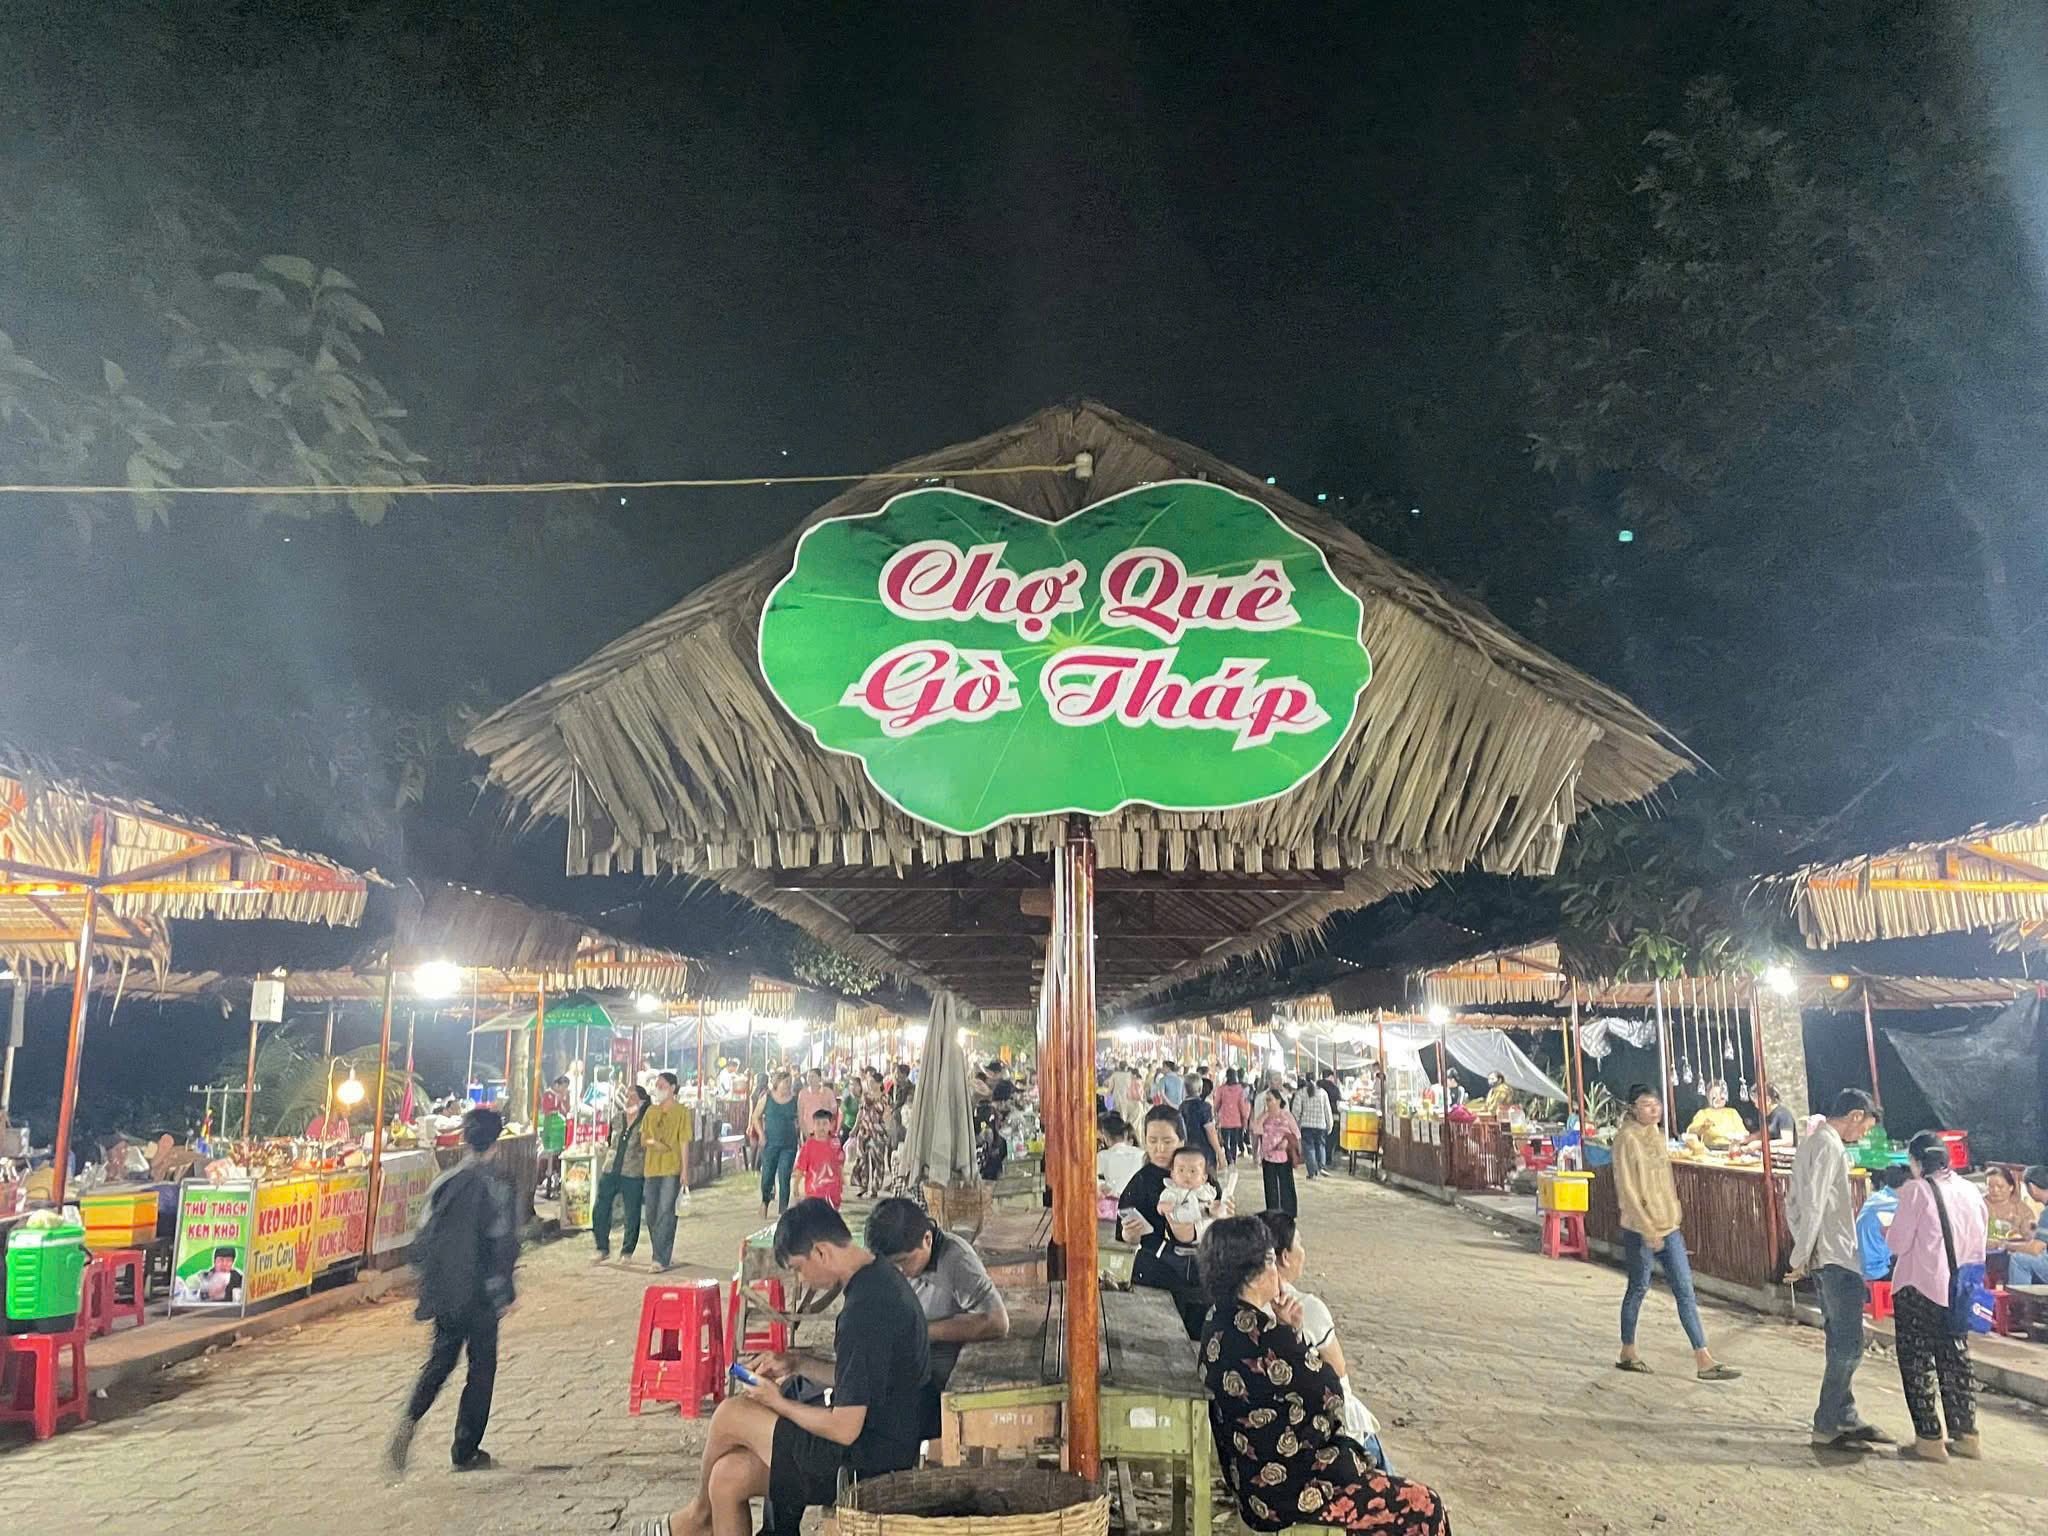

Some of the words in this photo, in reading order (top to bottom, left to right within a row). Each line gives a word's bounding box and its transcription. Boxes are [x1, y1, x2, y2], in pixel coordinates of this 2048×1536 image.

[886, 548, 1079, 633] Chợ
[1107, 555, 1289, 635] Quê
[853, 649, 1013, 729] Gò
[1047, 654, 1318, 738] Tháp
